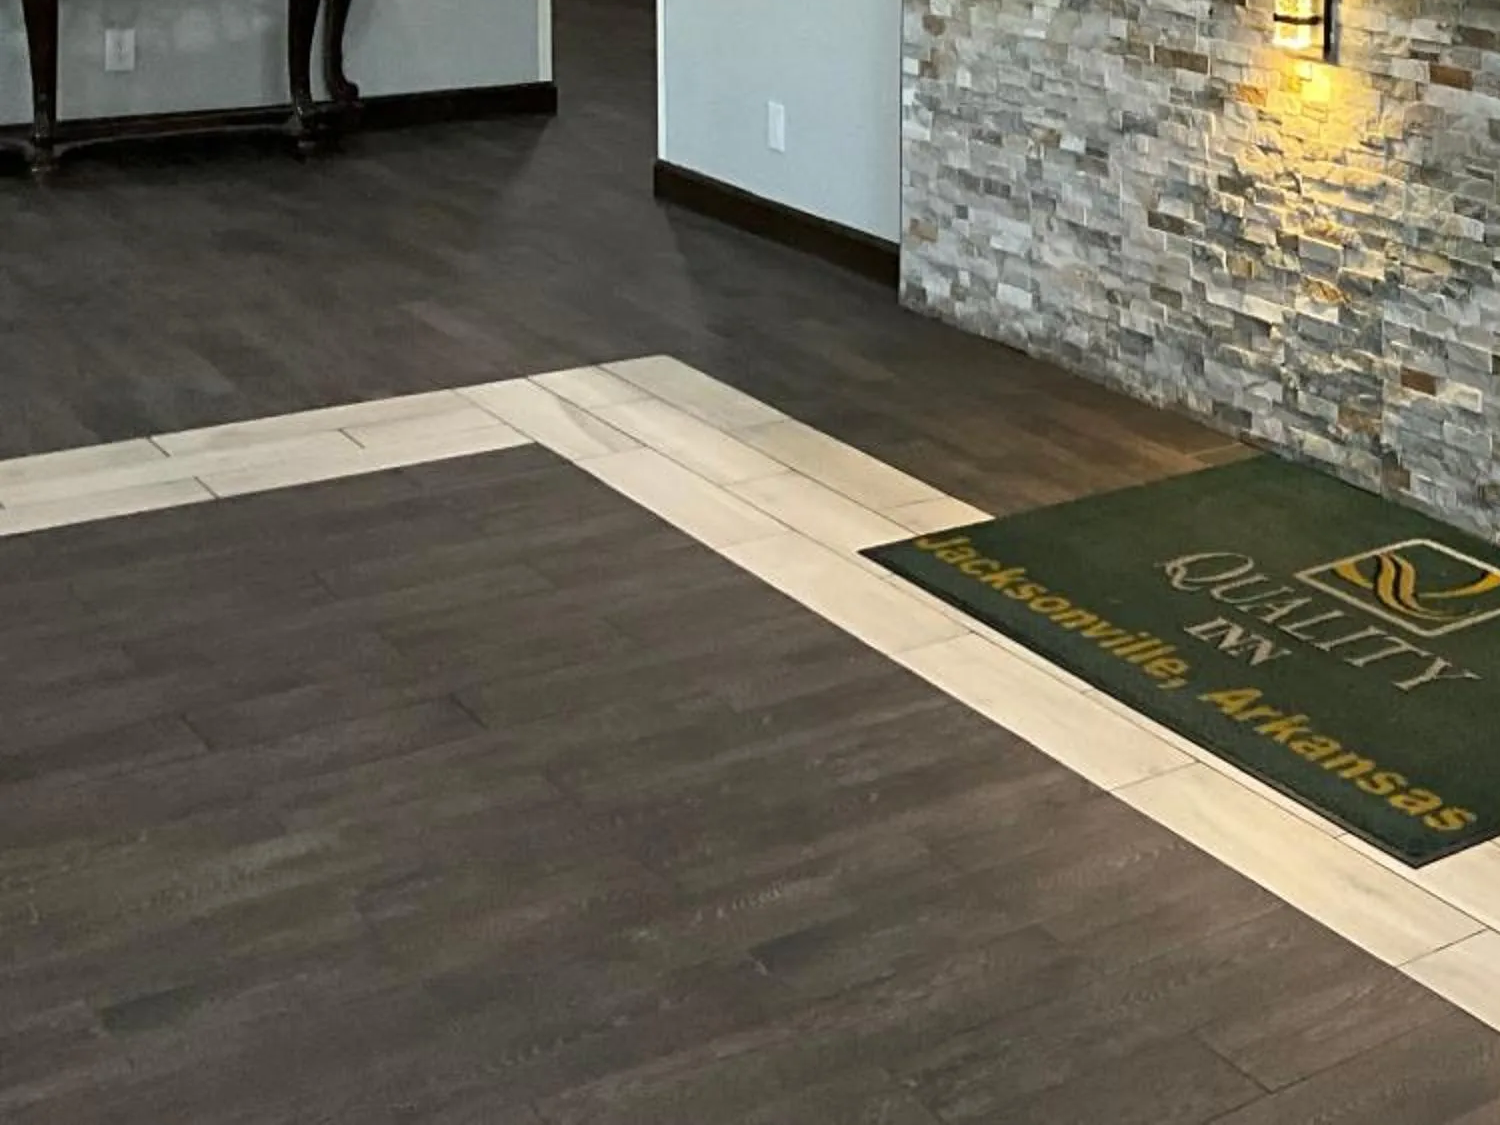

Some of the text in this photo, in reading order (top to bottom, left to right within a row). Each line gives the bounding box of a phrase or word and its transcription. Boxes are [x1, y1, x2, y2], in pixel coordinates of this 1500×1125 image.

[914, 534, 1479, 831] Jacksonville, Arkansas
[1155, 551, 1483, 692] QUALITY
[1183, 615, 1293, 666] INN
